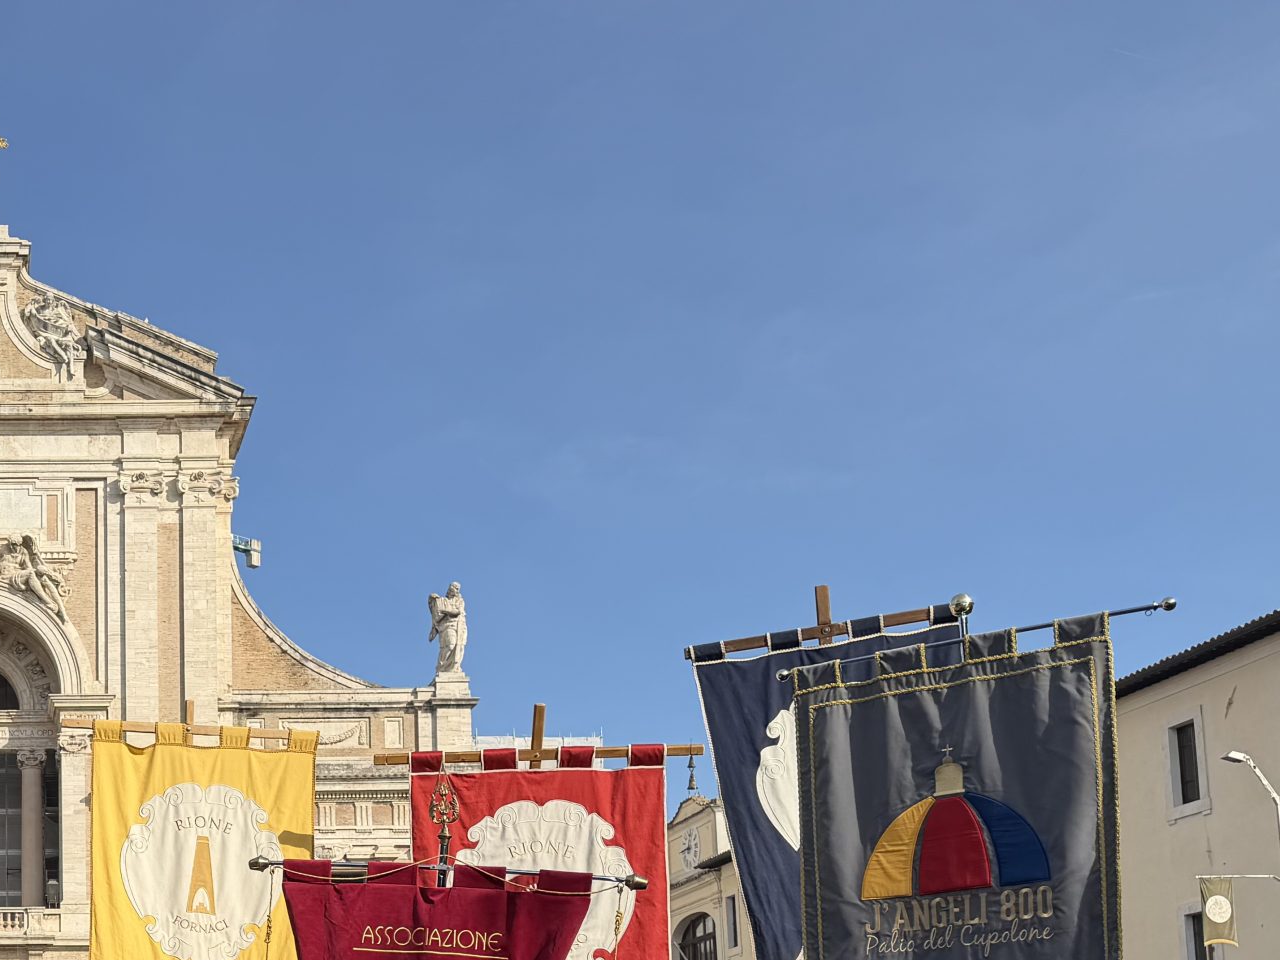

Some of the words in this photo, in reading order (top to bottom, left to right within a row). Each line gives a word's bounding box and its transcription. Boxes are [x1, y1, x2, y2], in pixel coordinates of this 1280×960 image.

[175, 815, 233, 835] RIONE
[507, 840, 575, 858] RIONE
[1000, 886, 1054, 921] 800
[172, 915, 229, 934] FORNACI
[361, 926, 503, 951] ASSOCIAZIONE
[865, 929, 915, 955] Palio
[924, 925, 953, 950] del
[960, 918, 1054, 957] Cupolone
